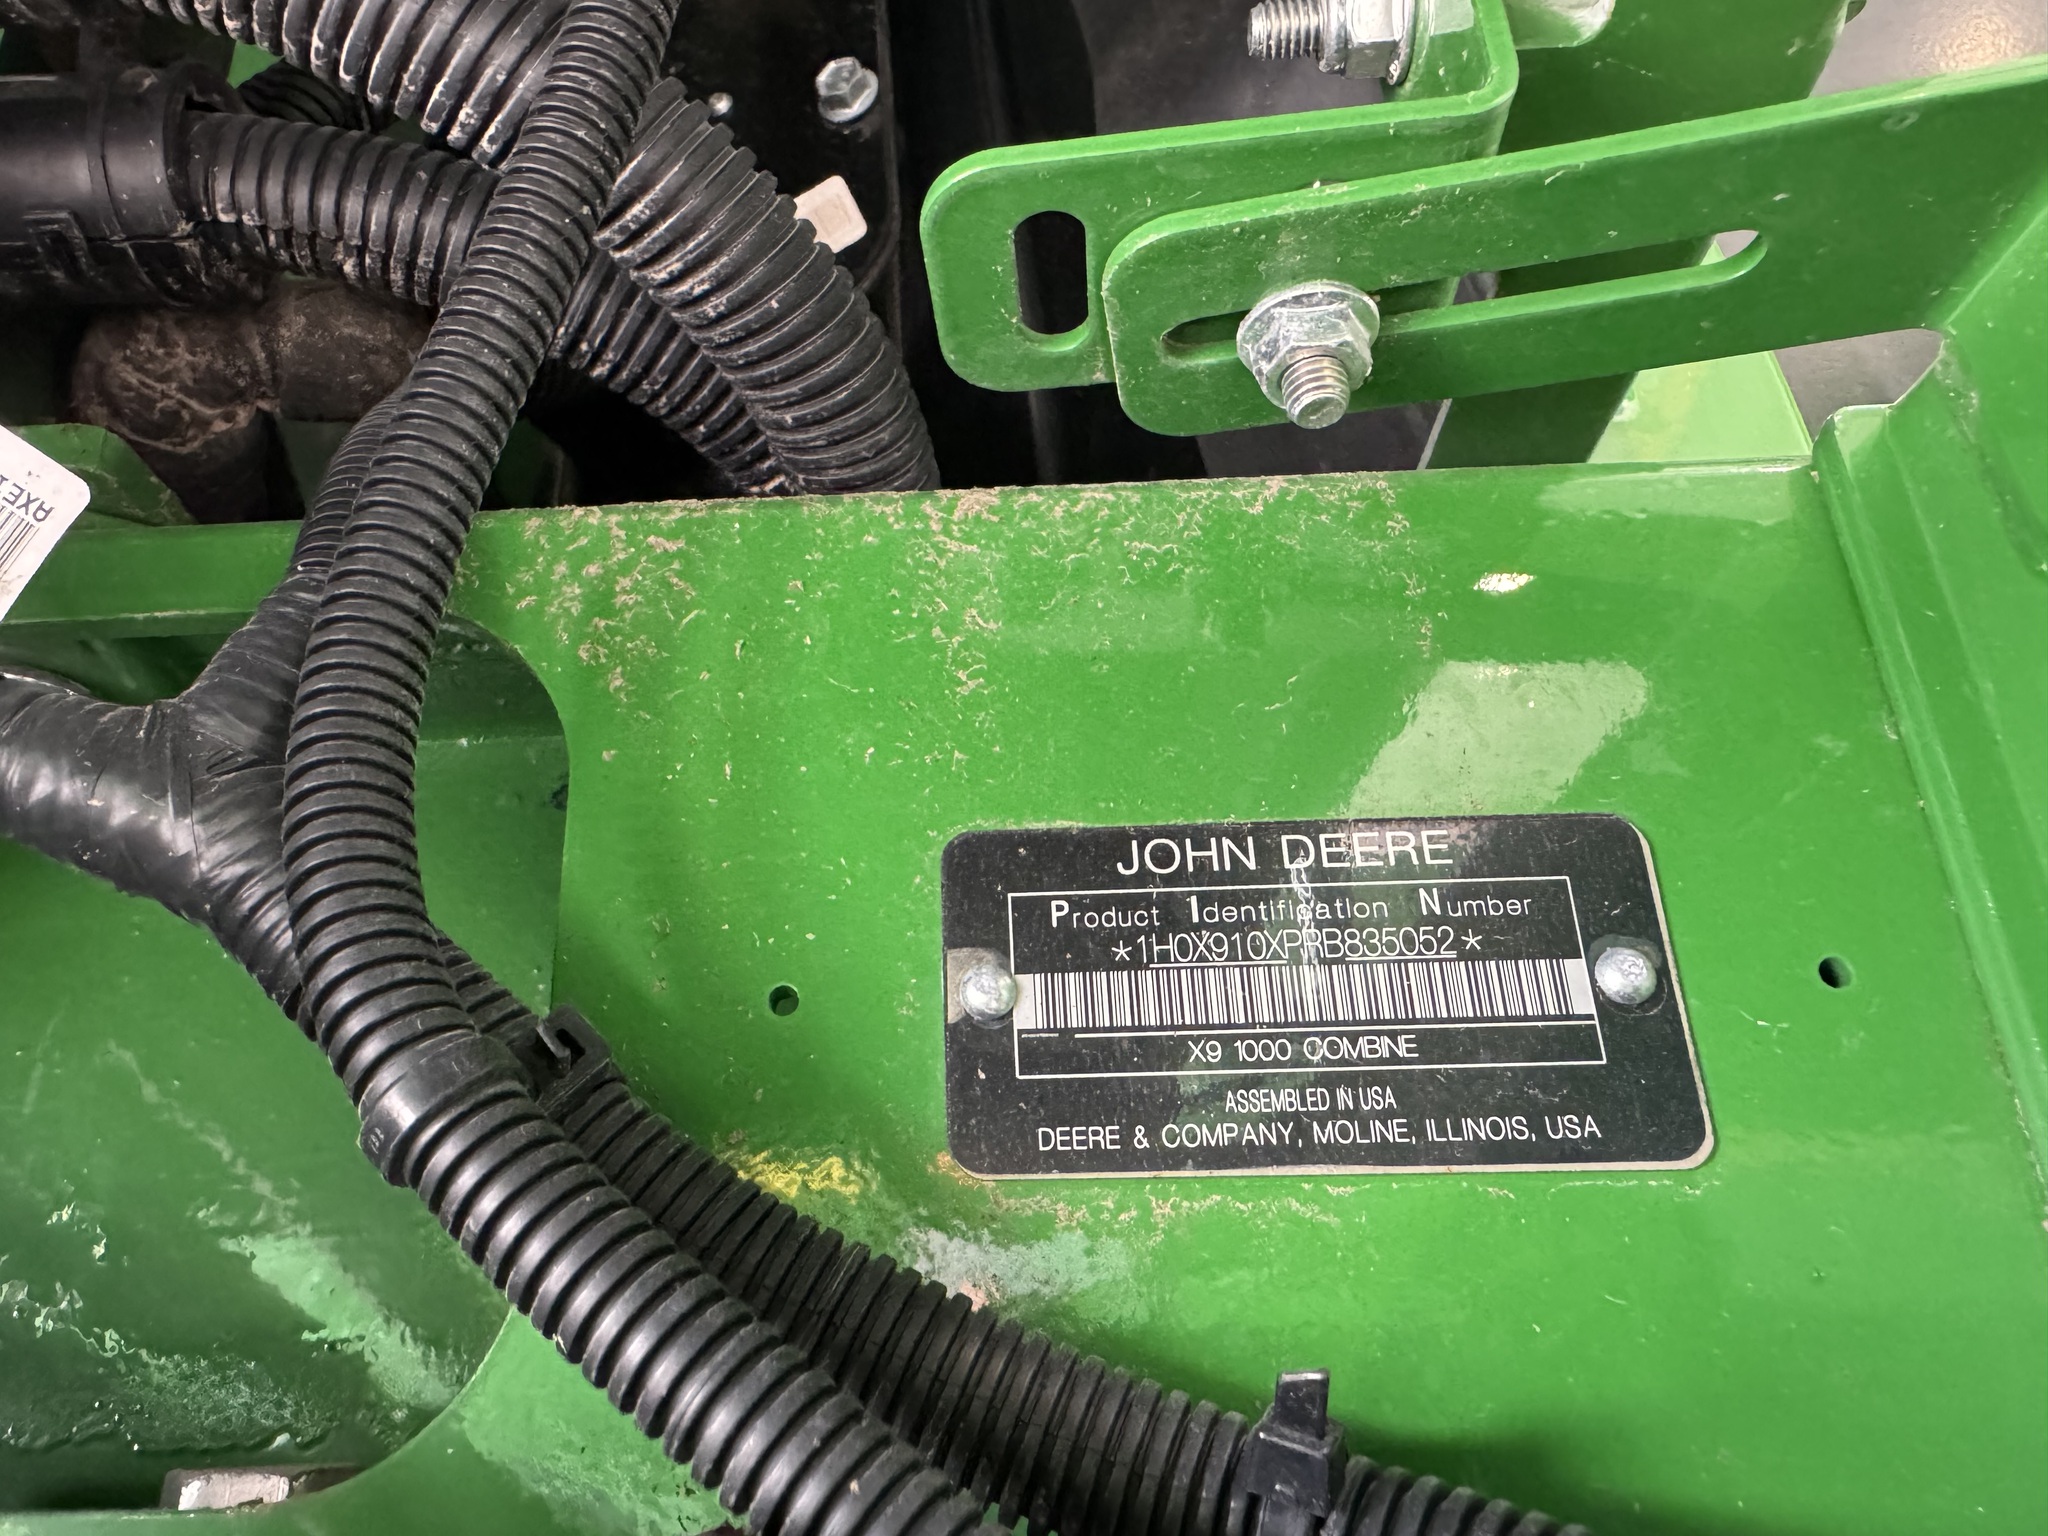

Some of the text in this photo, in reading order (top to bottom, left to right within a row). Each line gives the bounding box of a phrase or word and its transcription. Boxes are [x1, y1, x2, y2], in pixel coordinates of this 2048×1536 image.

[1116, 828, 1454, 876] JOHN DEERE
[1050, 887, 1533, 928] Product Identification Number
[1188, 1035, 1419, 1062] X9 1000 COMBINE
[1225, 1086, 1397, 1113] ASSEMBLED IN USA
[1038, 1115, 1602, 1151] DEERE & COMPANY, MOLINE, ILLINOIS, USA
